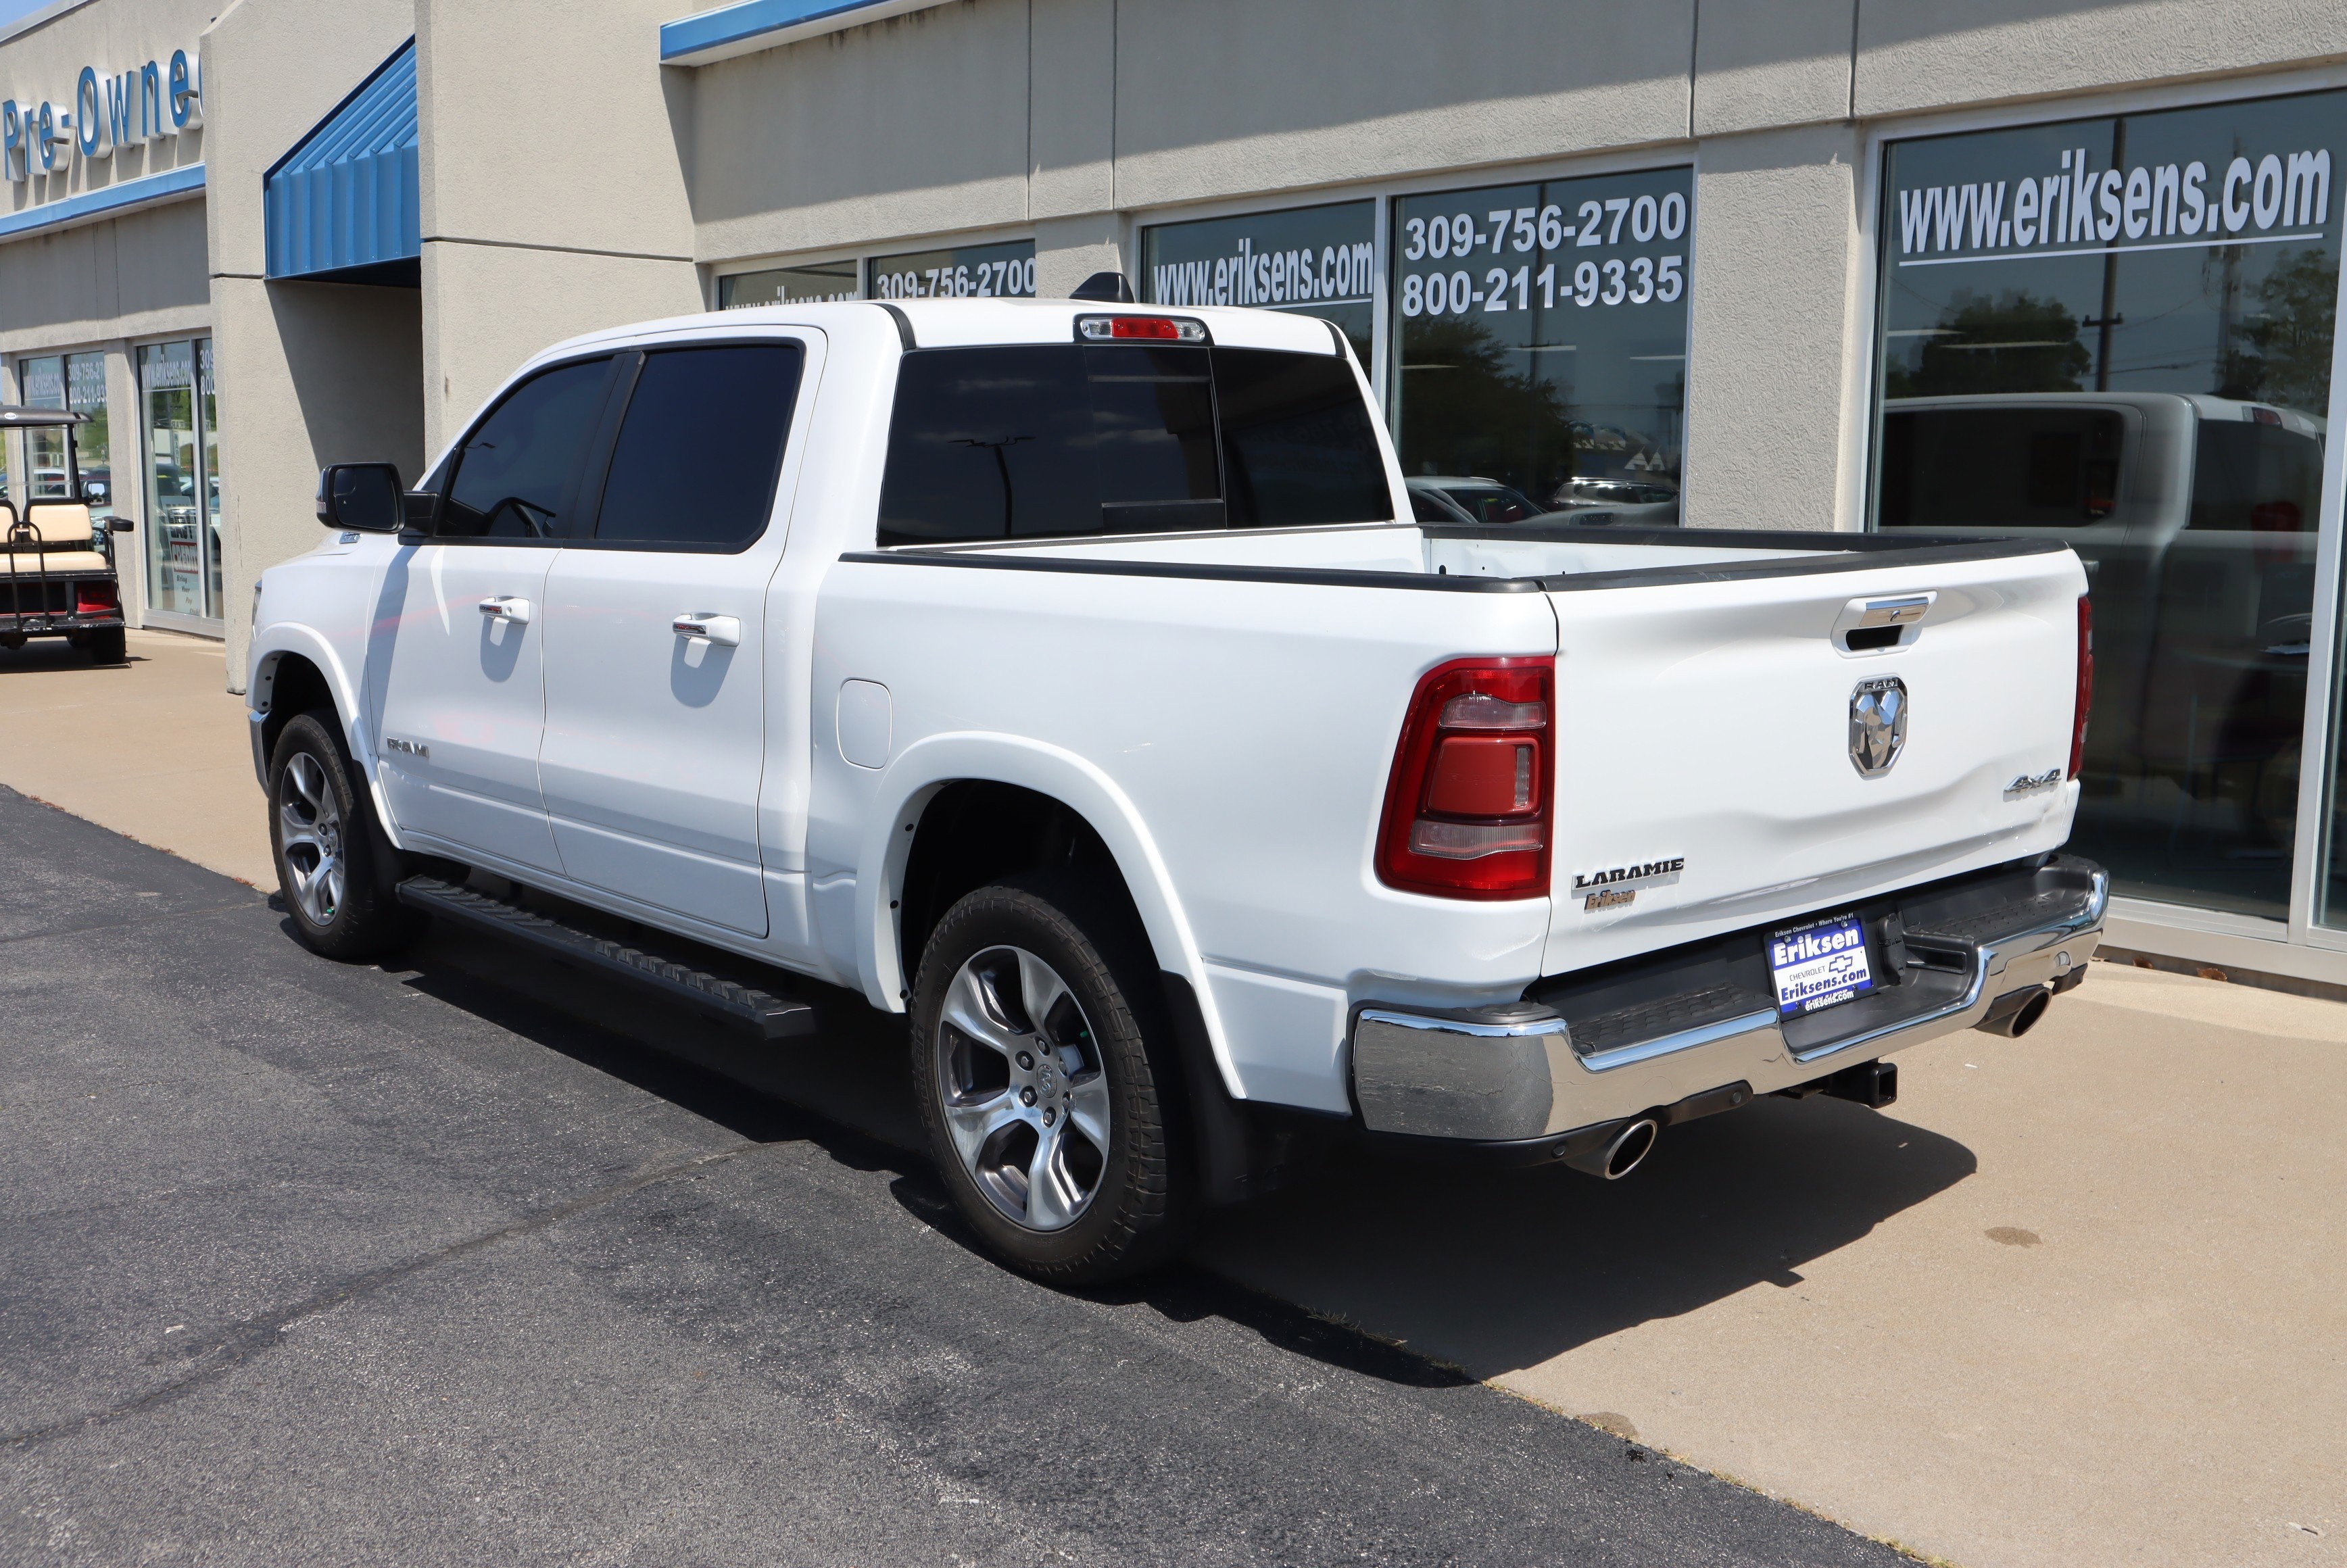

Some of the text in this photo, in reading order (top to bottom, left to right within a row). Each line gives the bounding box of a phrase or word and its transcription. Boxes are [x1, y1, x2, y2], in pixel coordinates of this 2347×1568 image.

[3, 49, 203, 181] Pre-Owne
[1900, 148, 2331, 253] www.eriksens.com
[1405, 192, 1686, 260] 309-756-2700
[877, 258, 1036, 299] 309-756-2700
[1154, 238, 1373, 305] www.eriksens.com
[1403, 255, 1683, 316] 800-211-9335
[1864, 678, 1899, 690] RAM
[1575, 857, 1685, 889] LARAMIE
[1584, 889, 1636, 910] Eriksen
[1774, 929, 1792, 937] Eriksen
[1793, 922, 1814, 933] Chevrolet
[1774, 929, 1859, 966] Eriksen
[1781, 969, 1866, 1002] Eriksens.com
[1789, 966, 1826, 981] CHEVROLET
[1805, 990, 1854, 1011] eriksens.com
